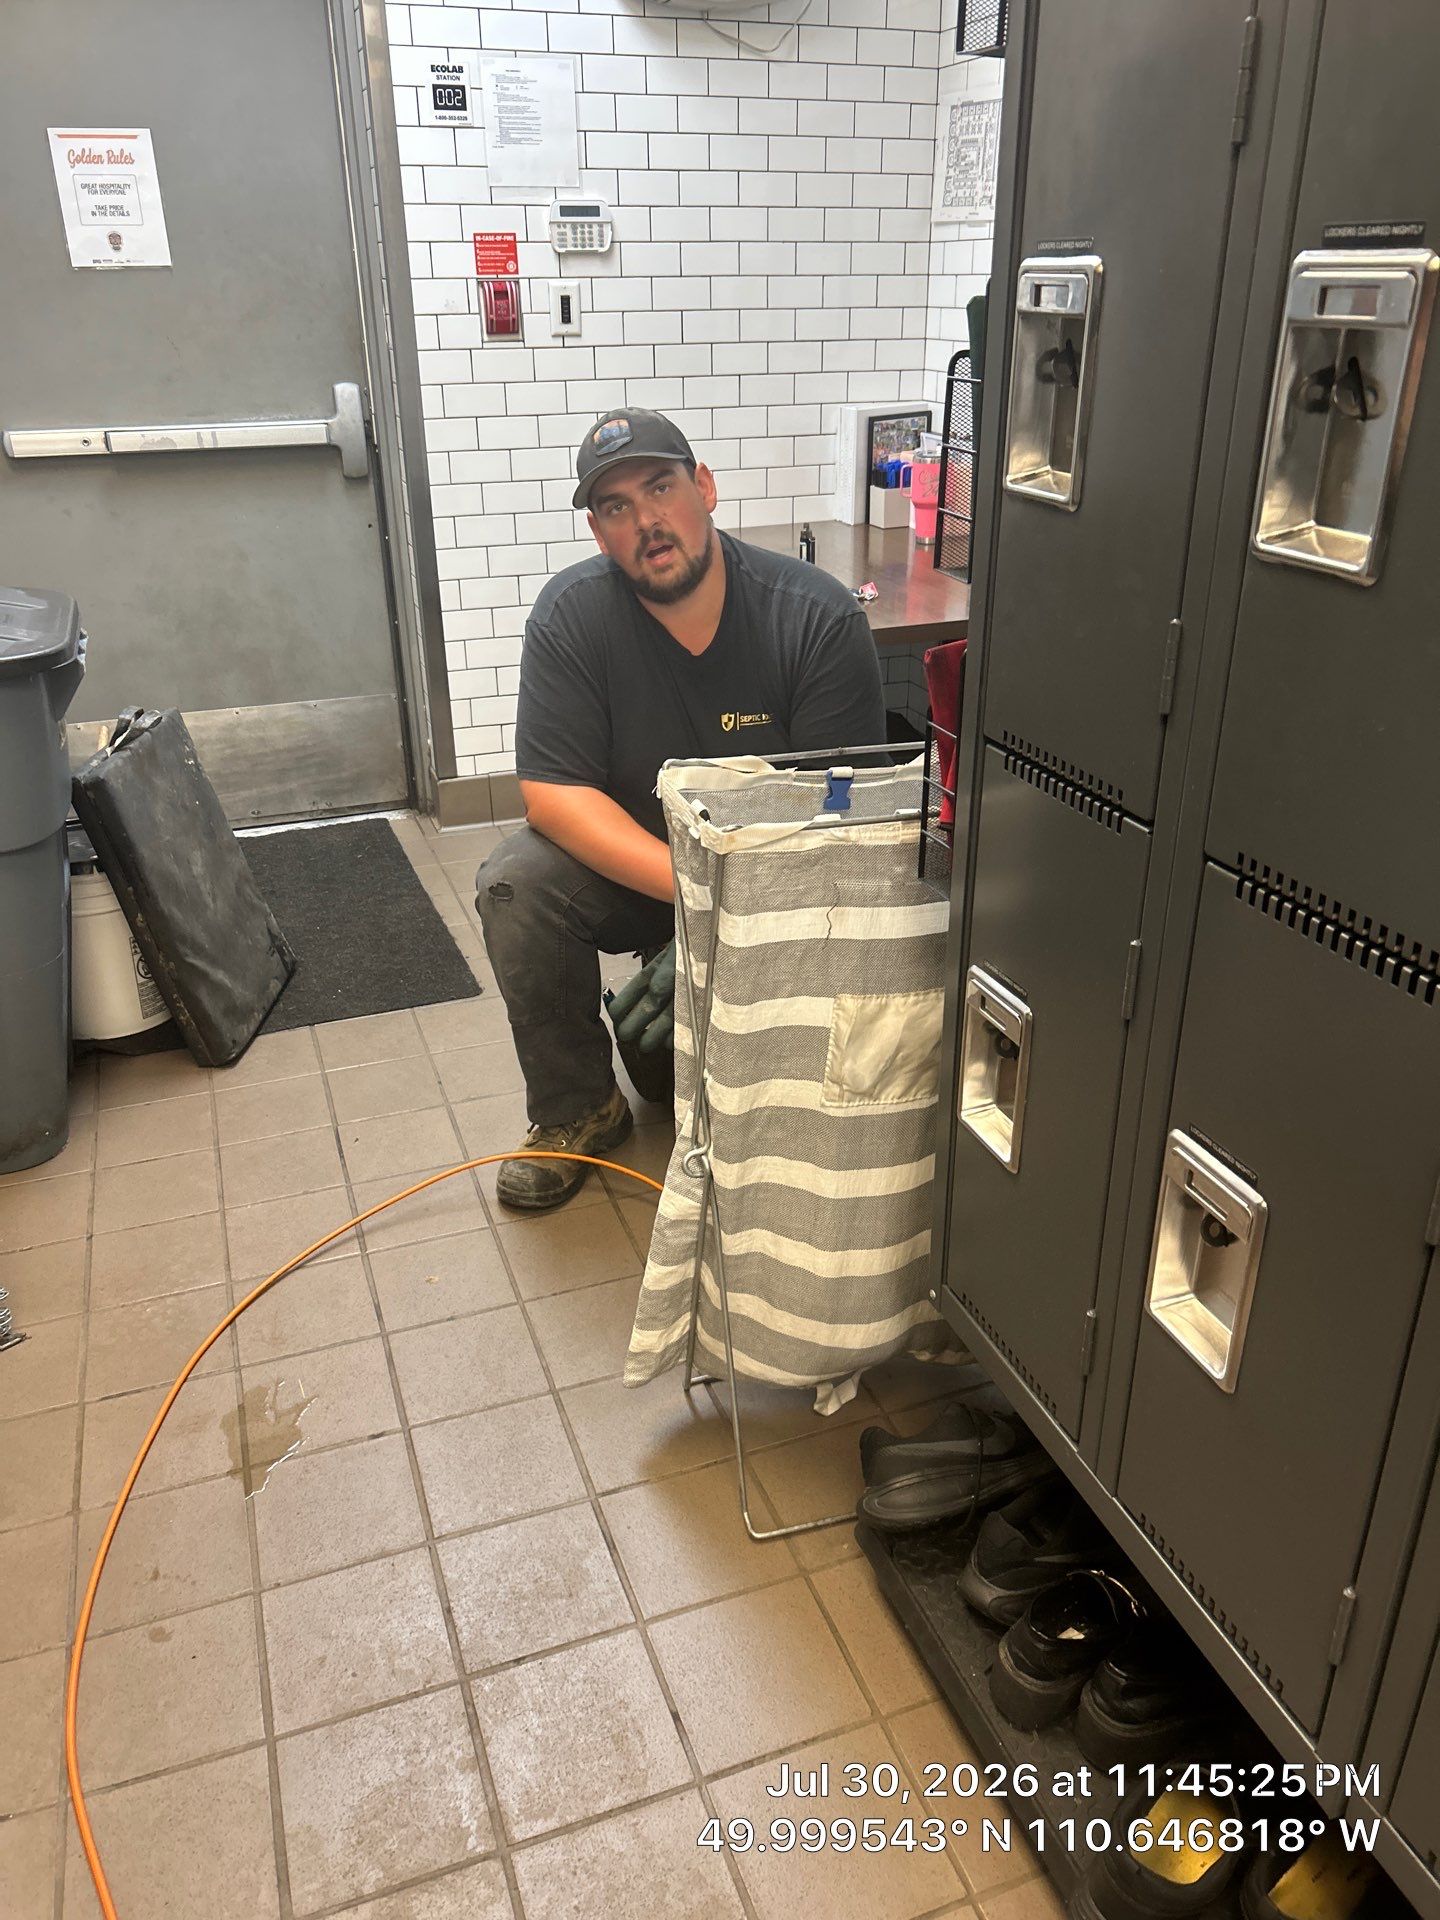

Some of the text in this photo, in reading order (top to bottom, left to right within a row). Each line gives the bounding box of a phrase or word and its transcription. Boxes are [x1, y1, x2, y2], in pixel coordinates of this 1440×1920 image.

[430, 64, 464, 73] ECOLAB
[436, 88, 463, 106] 002
[67, 147, 136, 169] Golden Rules
[80, 182, 97, 190] GREAT
[740, 714, 761, 723] SEPTIC
